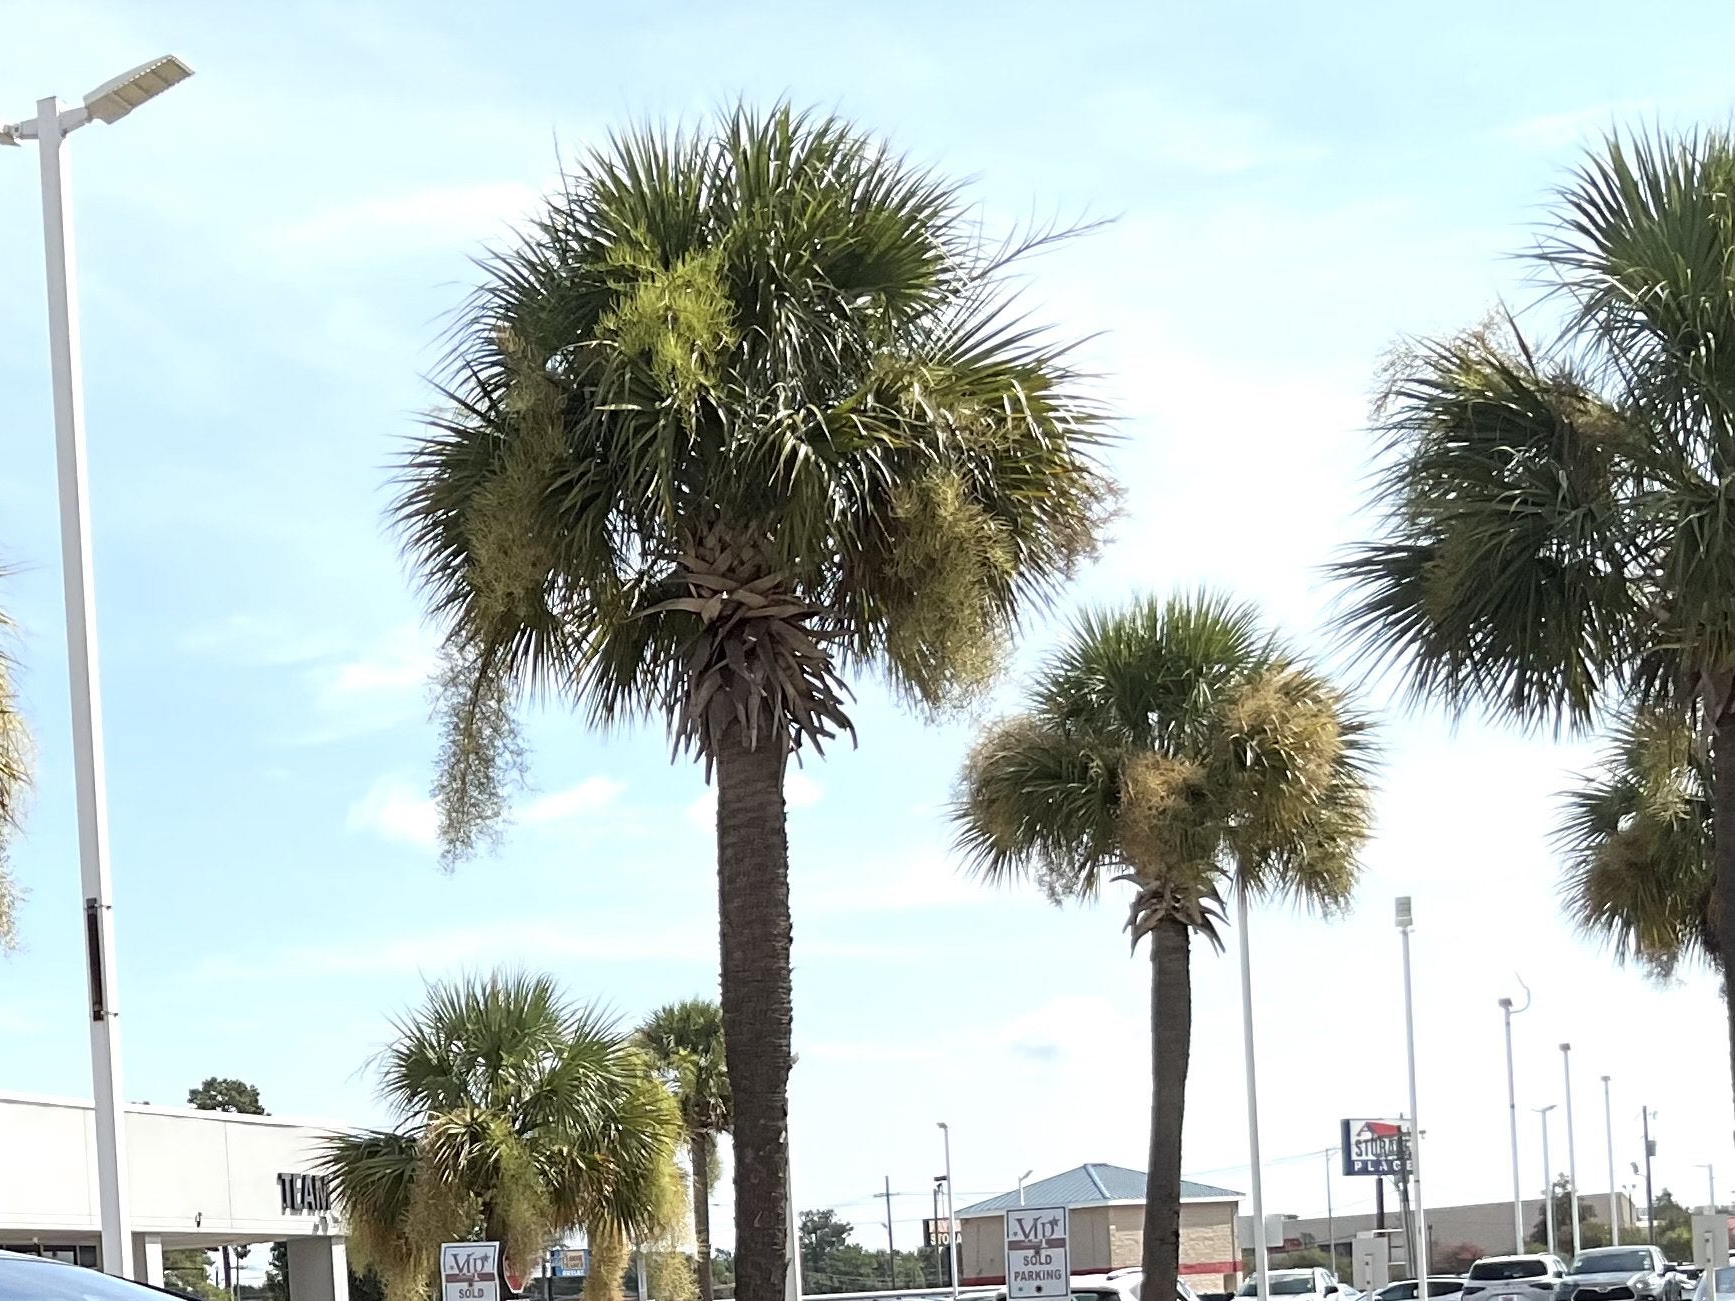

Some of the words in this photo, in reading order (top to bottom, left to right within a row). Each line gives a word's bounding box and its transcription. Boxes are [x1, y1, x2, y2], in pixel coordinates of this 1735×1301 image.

[1354, 1160, 1413, 1171] PLACE
[1023, 1254, 1052, 1267] SOLD
[1014, 1269, 1062, 1282] PARKING
[458, 1288, 484, 1299] SOLD
